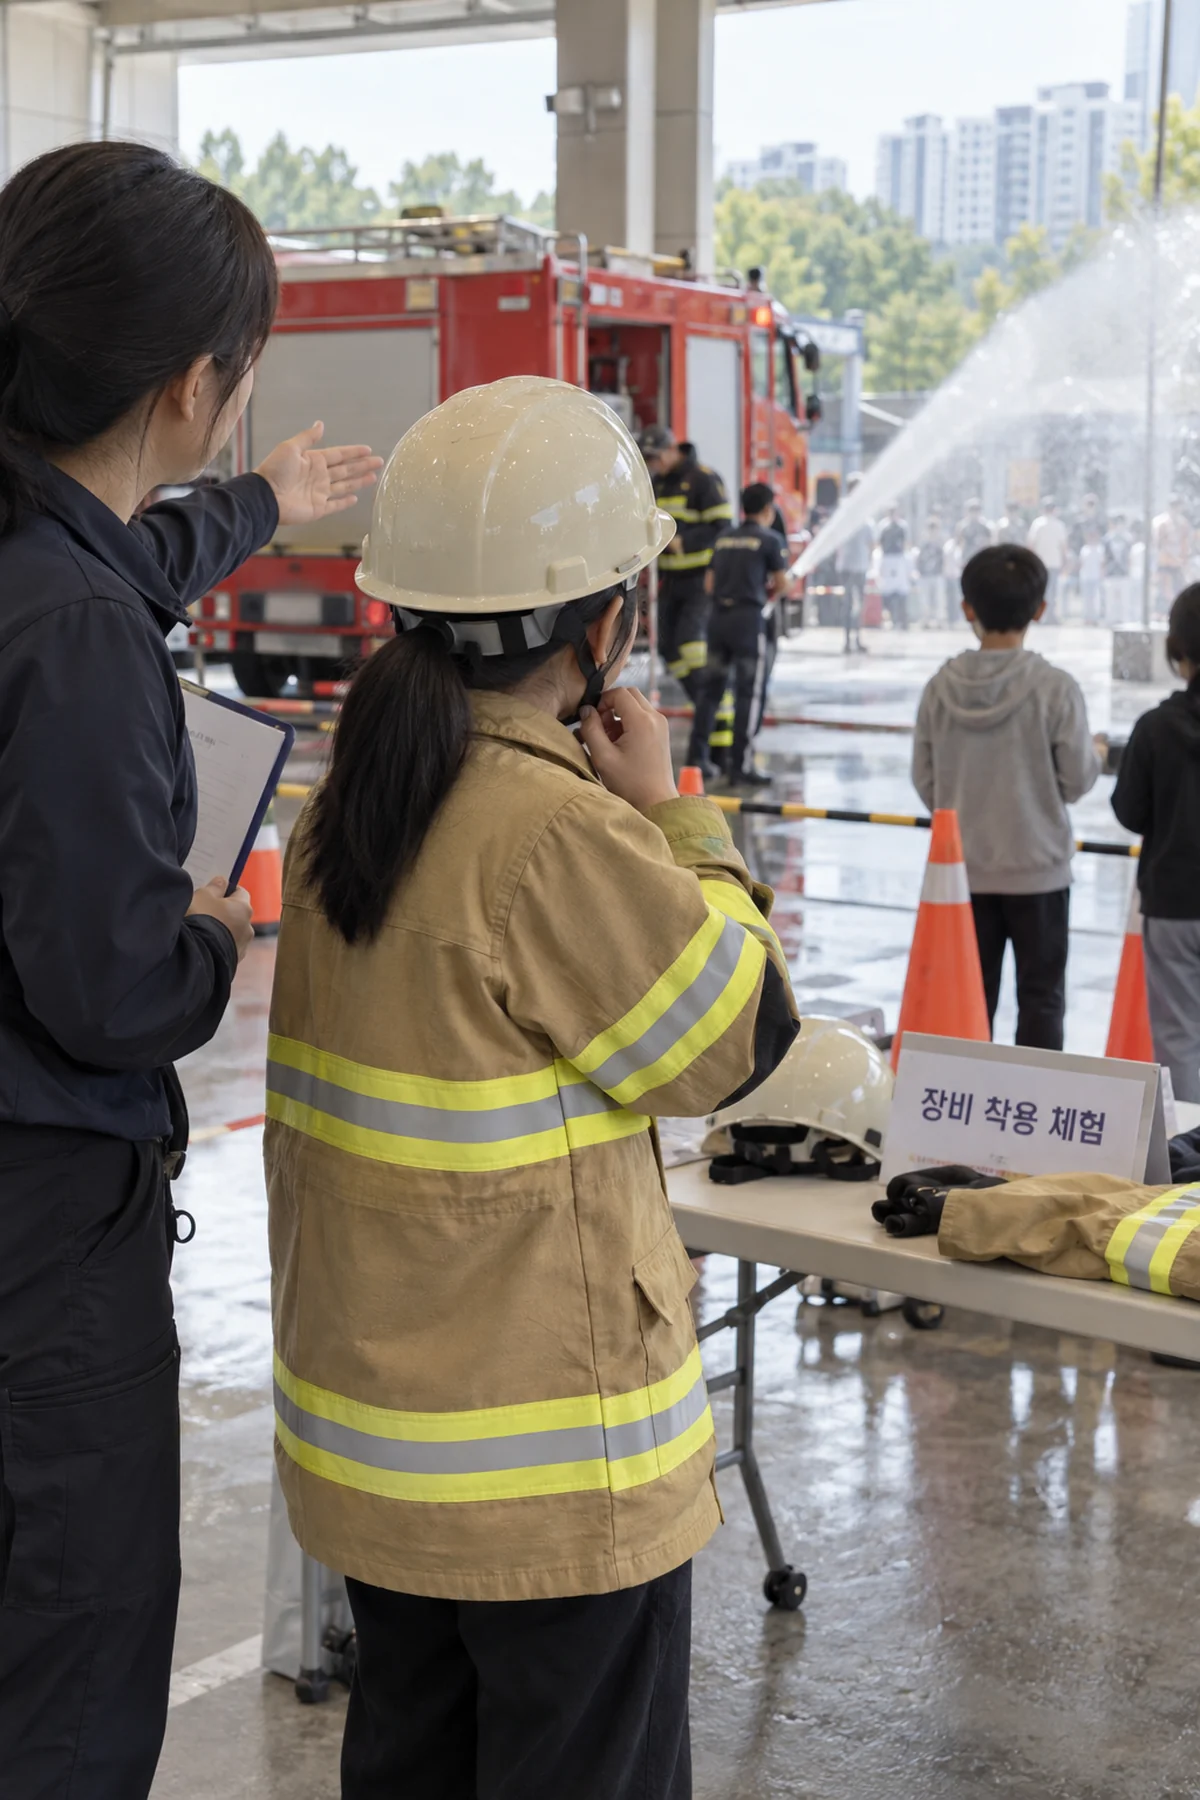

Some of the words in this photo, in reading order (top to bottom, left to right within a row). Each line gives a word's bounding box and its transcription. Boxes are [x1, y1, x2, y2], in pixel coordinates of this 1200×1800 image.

[920, 1087, 974, 1126] 장비
[984, 1096, 1039, 1136] 착용
[1048, 1105, 1106, 1146] 체험
